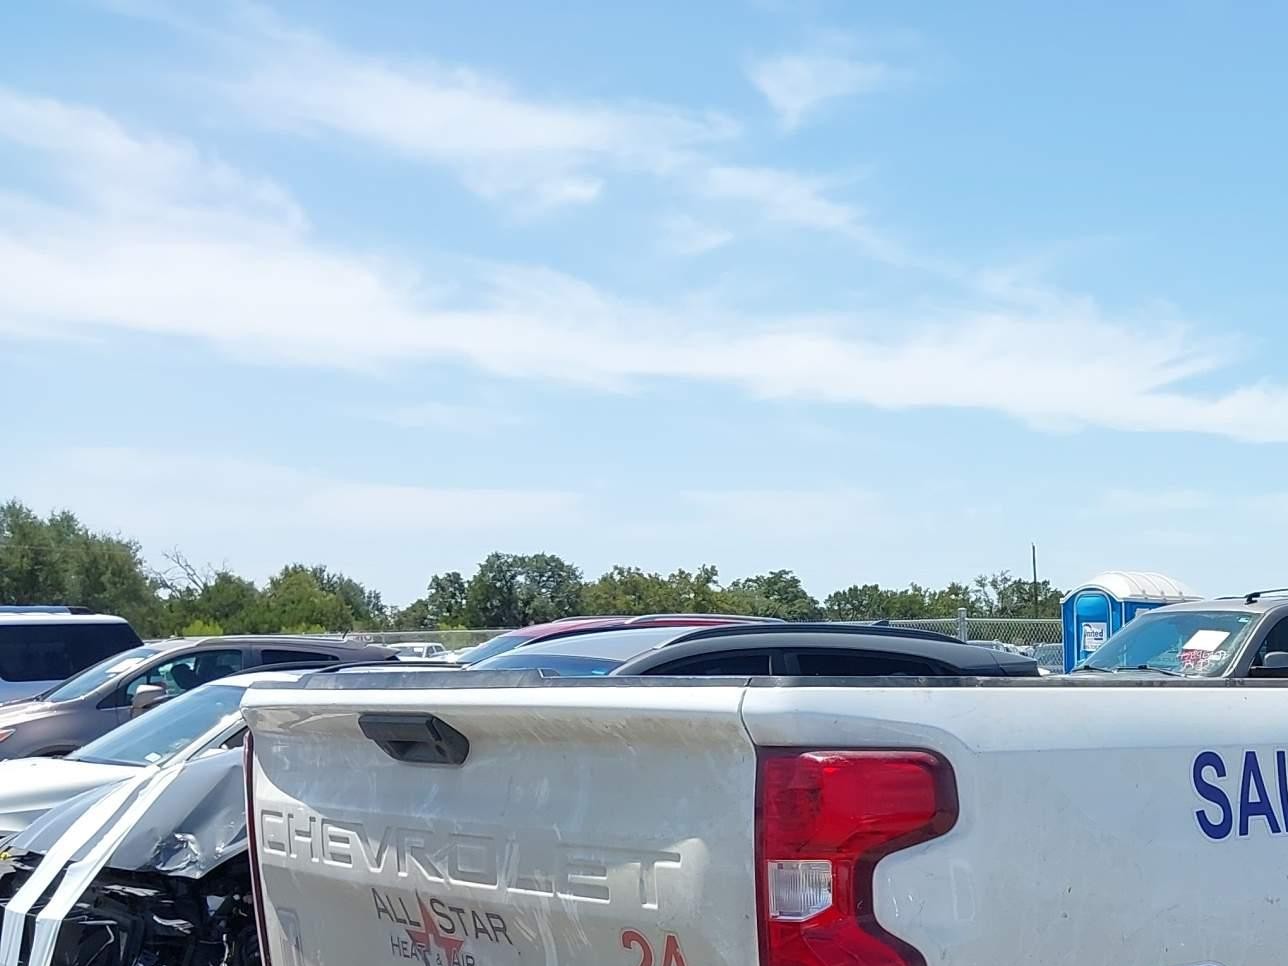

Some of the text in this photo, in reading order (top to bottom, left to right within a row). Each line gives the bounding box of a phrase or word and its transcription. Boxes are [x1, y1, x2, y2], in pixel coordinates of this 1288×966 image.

[260, 808, 682, 910] CHEVROLET
[371, 887, 514, 945] ALL STAR
[390, 936, 427, 962] HEAT
[435, 954, 443, 966] &
